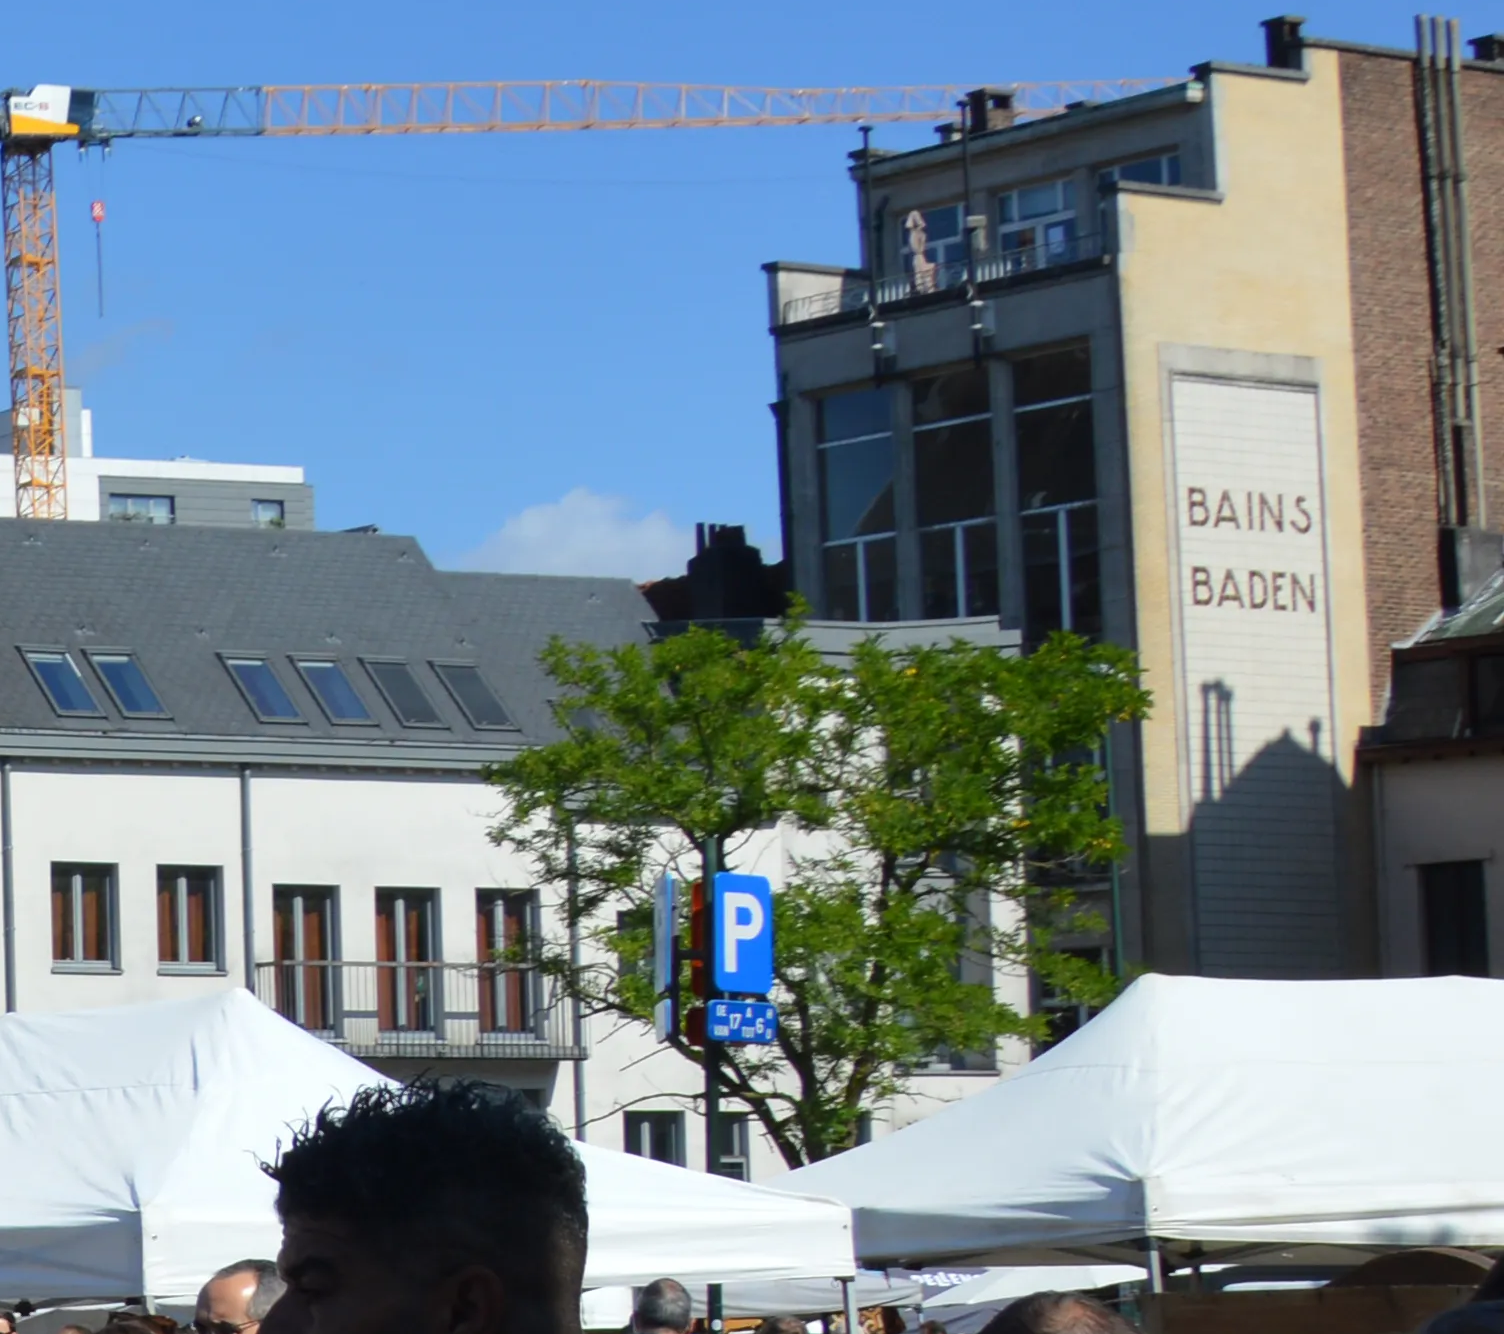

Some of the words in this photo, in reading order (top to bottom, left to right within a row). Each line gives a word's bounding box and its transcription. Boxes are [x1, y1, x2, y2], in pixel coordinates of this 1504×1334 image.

[1188, 487, 1312, 535] BAINS
[1192, 566, 1315, 613] BADEN
[724, 892, 764, 973] P
[716, 1005, 727, 1016] DE
[730, 1014, 742, 1029] 17
[756, 1018, 764, 1034] 6
